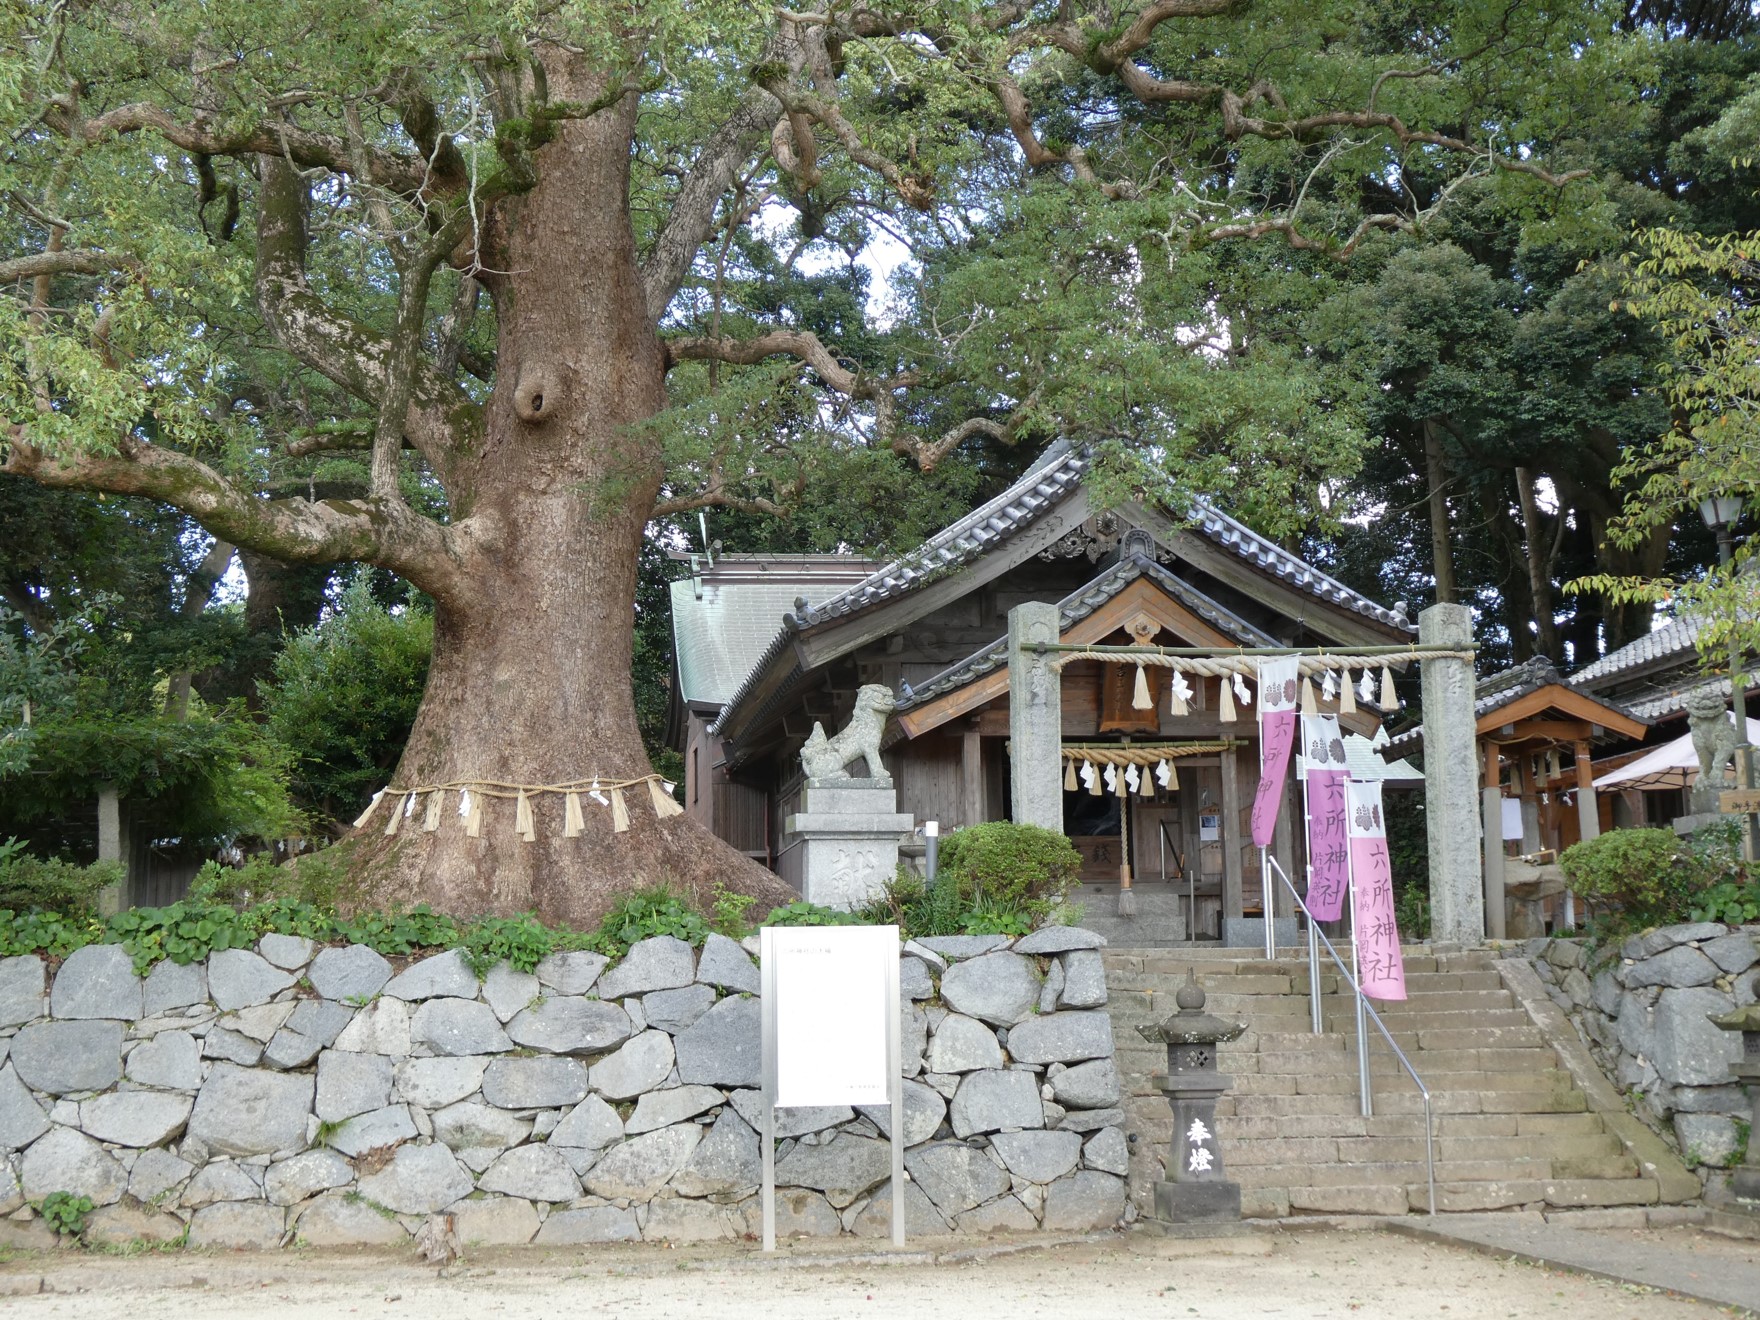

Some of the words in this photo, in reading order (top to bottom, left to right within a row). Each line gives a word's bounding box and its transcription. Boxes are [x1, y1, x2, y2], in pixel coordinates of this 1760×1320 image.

[1251, 715, 1291, 832] 六所神社
[1319, 775, 1348, 907] 六所神社
[1367, 843, 1399, 983] 六所神社
